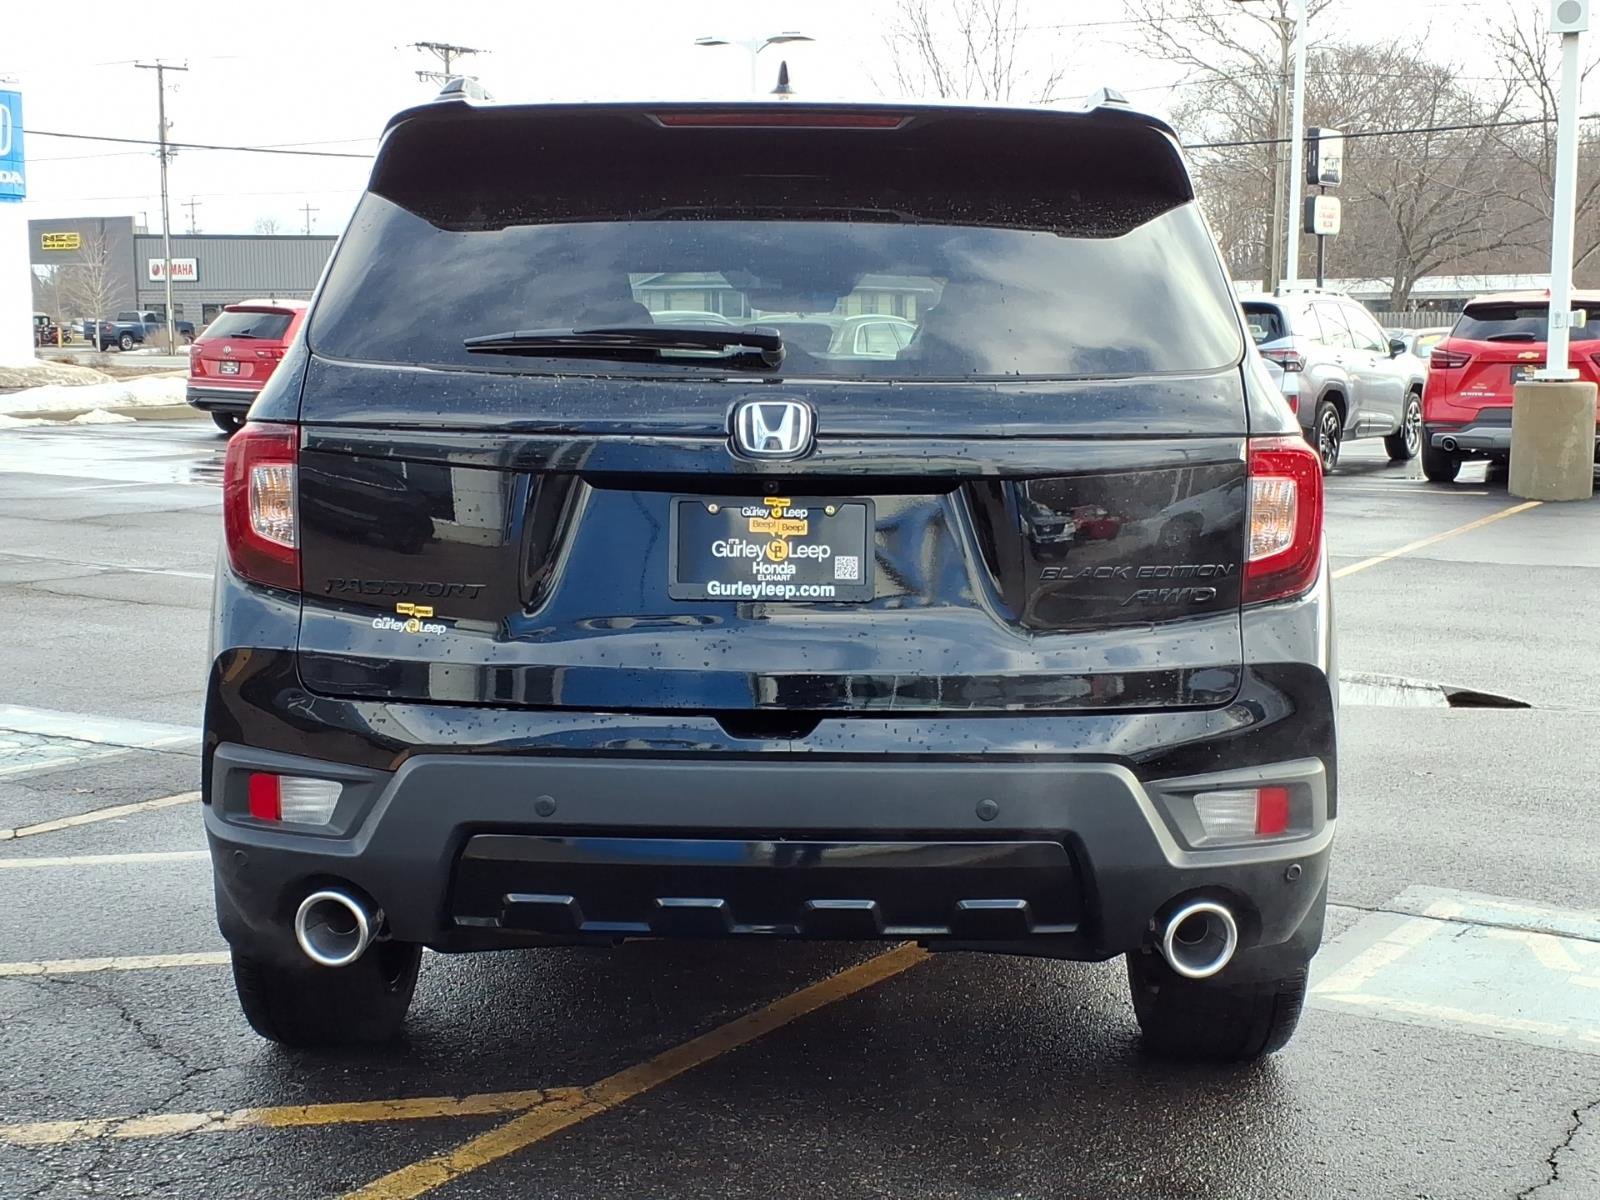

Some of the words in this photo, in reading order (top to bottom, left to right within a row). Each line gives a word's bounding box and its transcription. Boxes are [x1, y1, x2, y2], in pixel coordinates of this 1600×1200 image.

[783, 508, 809, 519] Leep
[752, 520, 776, 529] Beep!
[781, 523, 806, 533] Beep!
[788, 540, 831, 562] Leep
[752, 561, 796, 575] Honda
[1039, 566, 1133, 580] BLACK
[1135, 563, 1234, 578] EDITION
[757, 574, 791, 582] ELKHART
[324, 578, 487, 600] PASSPORT
[706, 581, 836, 599] Gurleyleep.com
[1121, 586, 1217, 607] AWD
[419, 621, 447, 636] Leep
